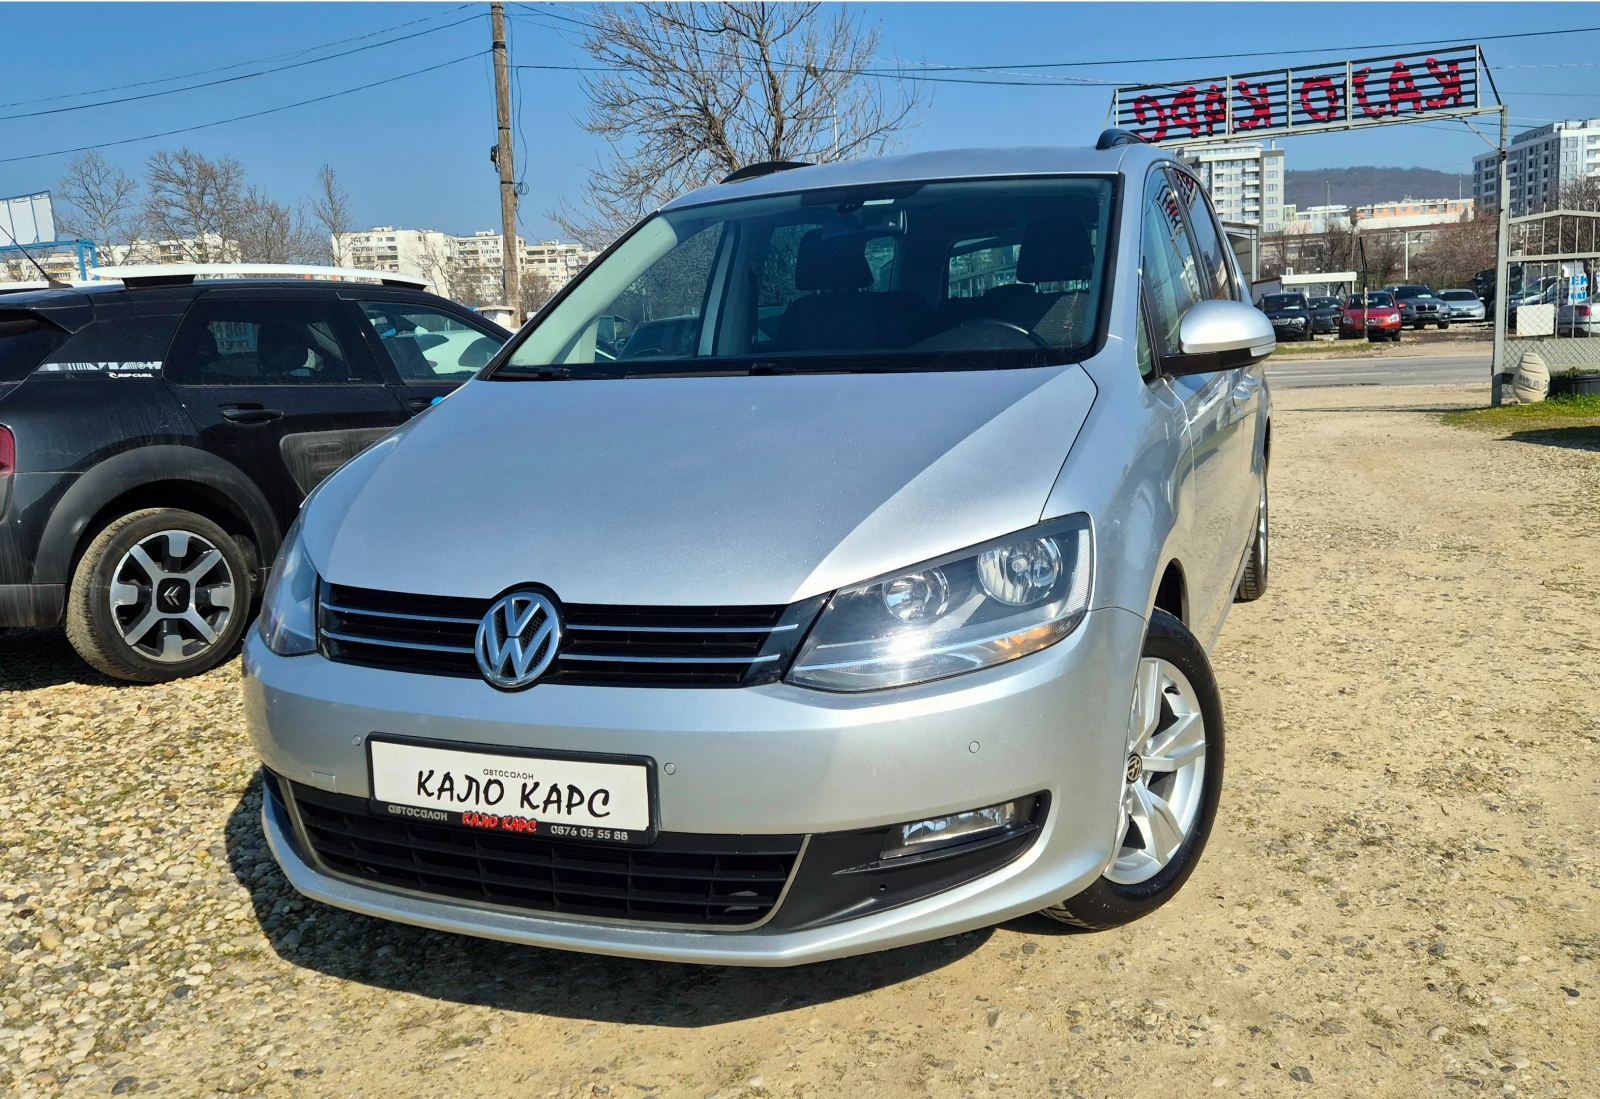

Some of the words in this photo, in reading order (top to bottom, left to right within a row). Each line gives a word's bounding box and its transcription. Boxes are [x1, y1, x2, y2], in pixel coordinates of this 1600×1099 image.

[483, 768, 534, 780] автосалон
[417, 769, 505, 806] КАЛО
[520, 781, 611, 818] КАРС
[388, 804, 448, 821] автосалон
[461, 811, 499, 828] КАЛО
[501, 815, 537, 833] КАРС
[550, 825, 577, 836] 0876
[580, 828, 594, 838] 05
[597, 830, 611, 839] 55
[613, 831, 628, 840] 88
